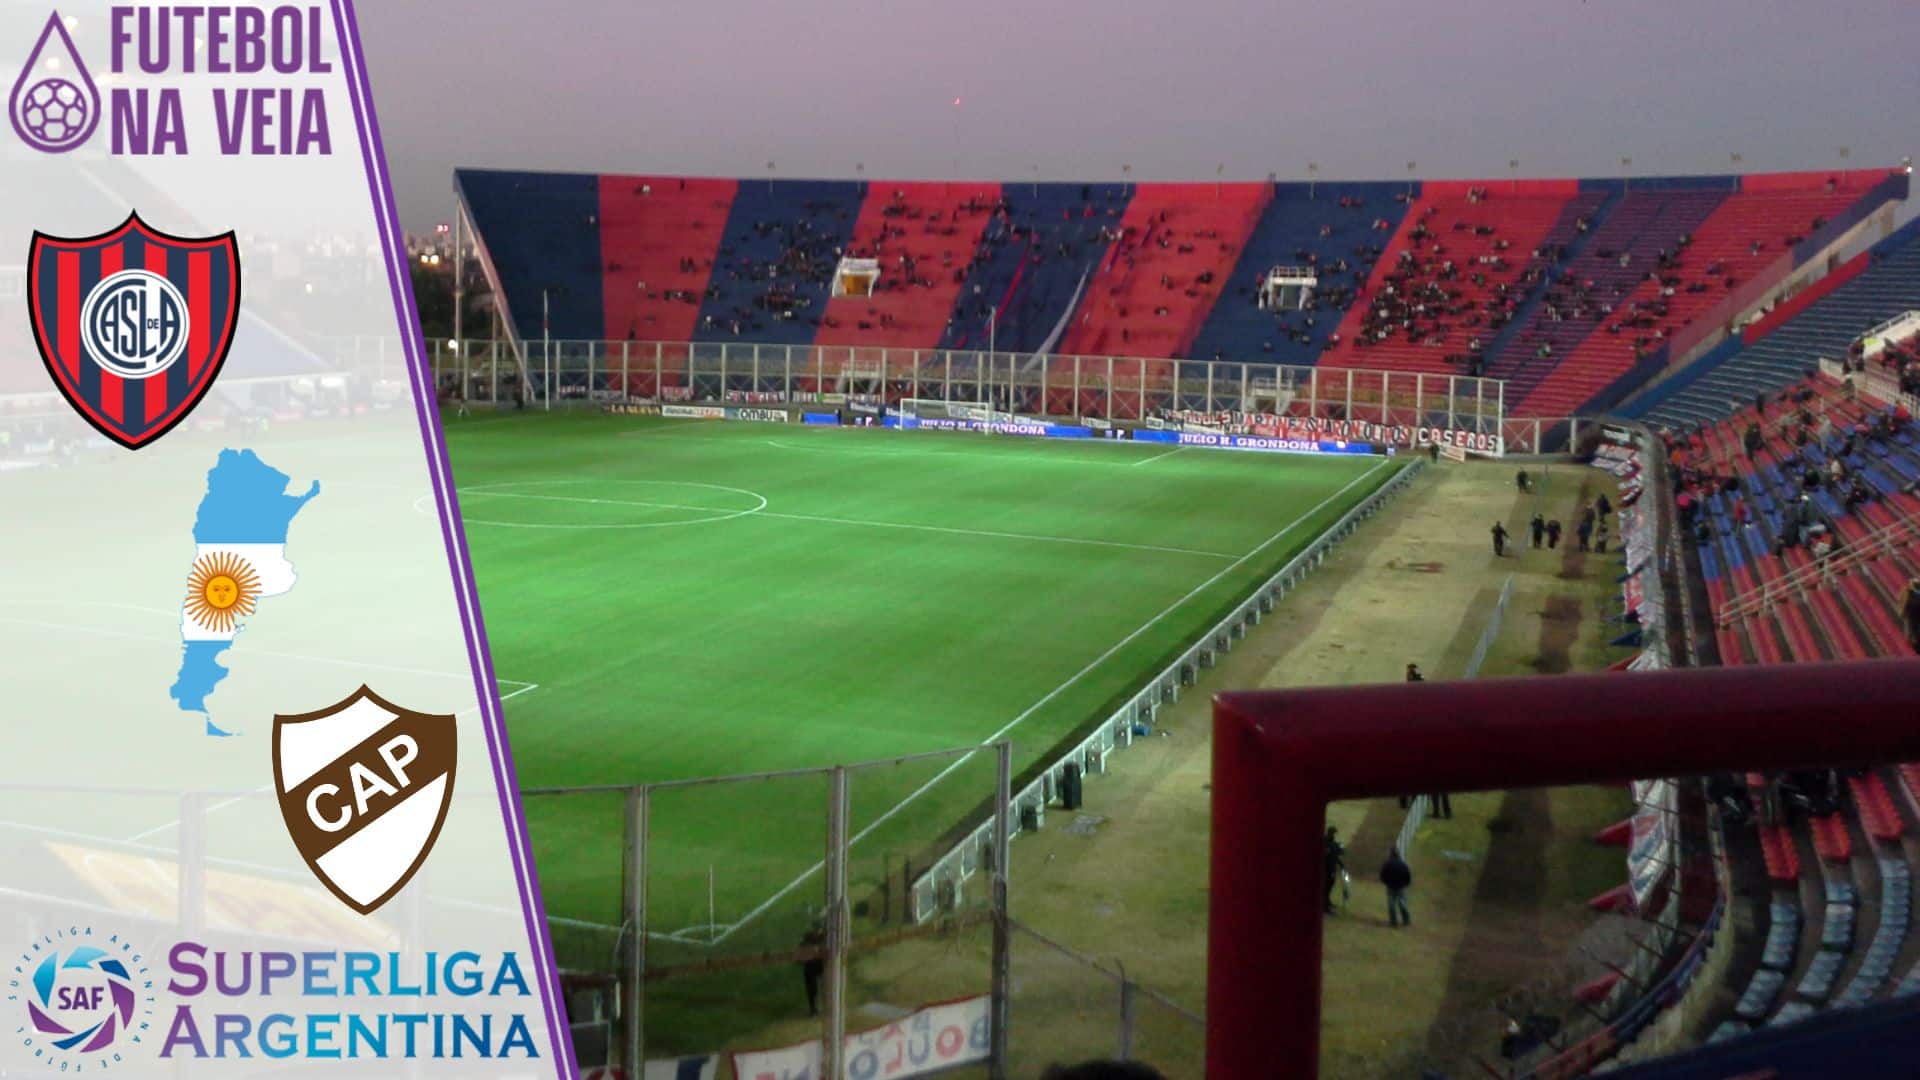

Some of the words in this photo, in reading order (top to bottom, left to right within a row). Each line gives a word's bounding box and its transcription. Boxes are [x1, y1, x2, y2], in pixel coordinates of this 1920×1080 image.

[1179, 432, 1217, 444] JULIO
[1236, 437, 1319, 451] GRONDONA
[1418, 427, 1496, 450] CASEROS
